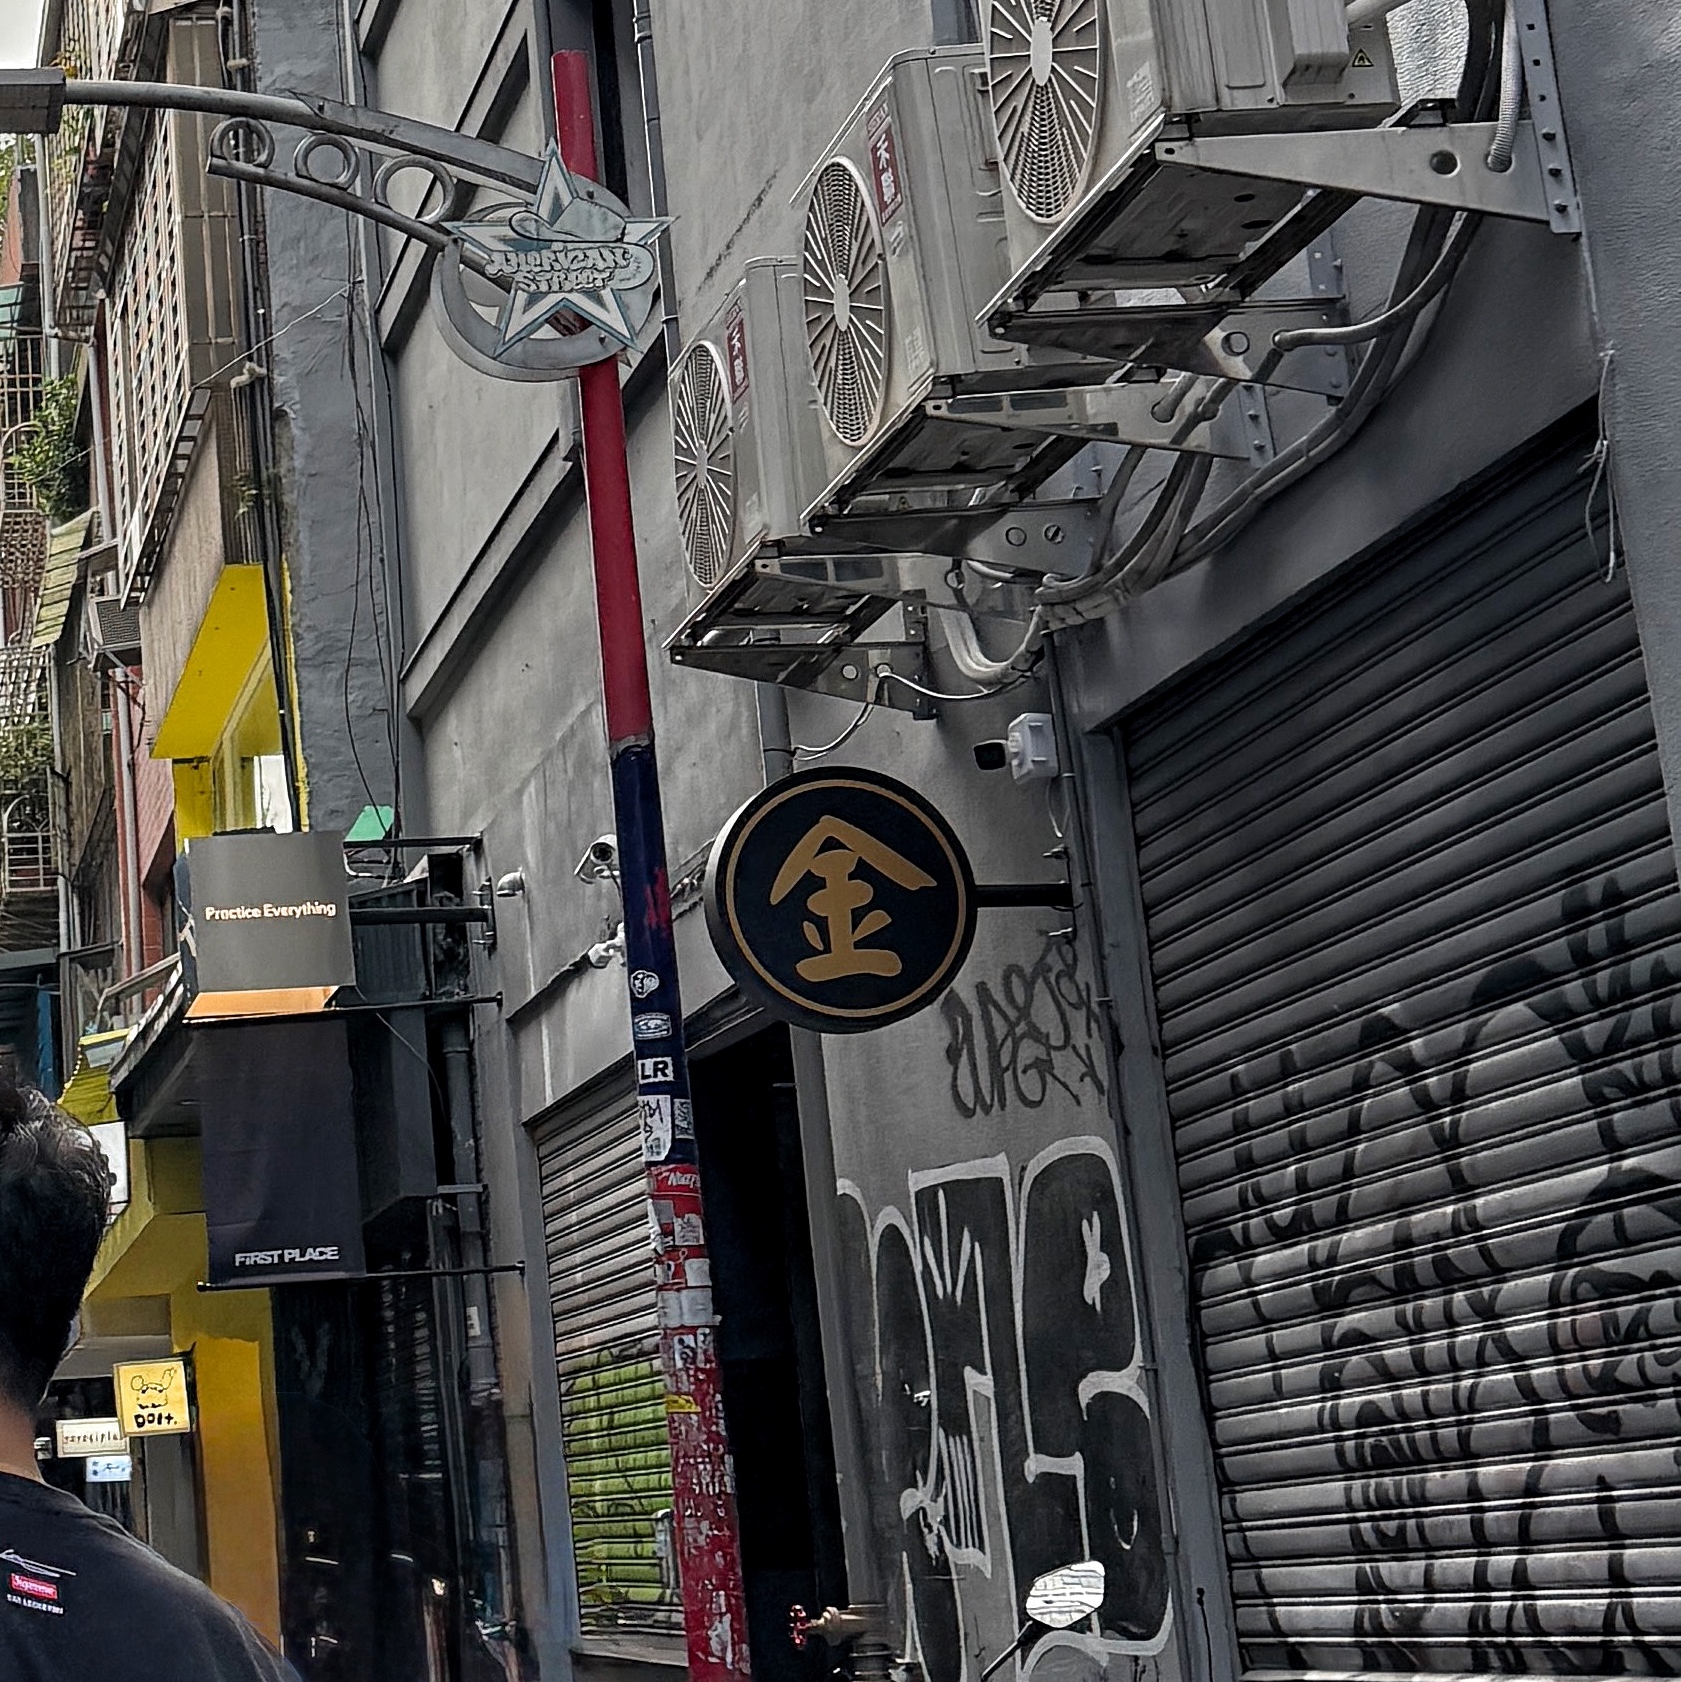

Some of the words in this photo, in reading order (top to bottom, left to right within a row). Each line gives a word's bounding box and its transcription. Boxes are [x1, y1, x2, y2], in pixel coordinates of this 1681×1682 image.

[770, 815, 937, 982] 金
[205, 906, 261, 920] Practice
[263, 901, 336, 918] Everything
[641, 1060, 669, 1080] LR
[235, 1250, 282, 1266] FIRST
[283, 1246, 339, 1262] PLACE
